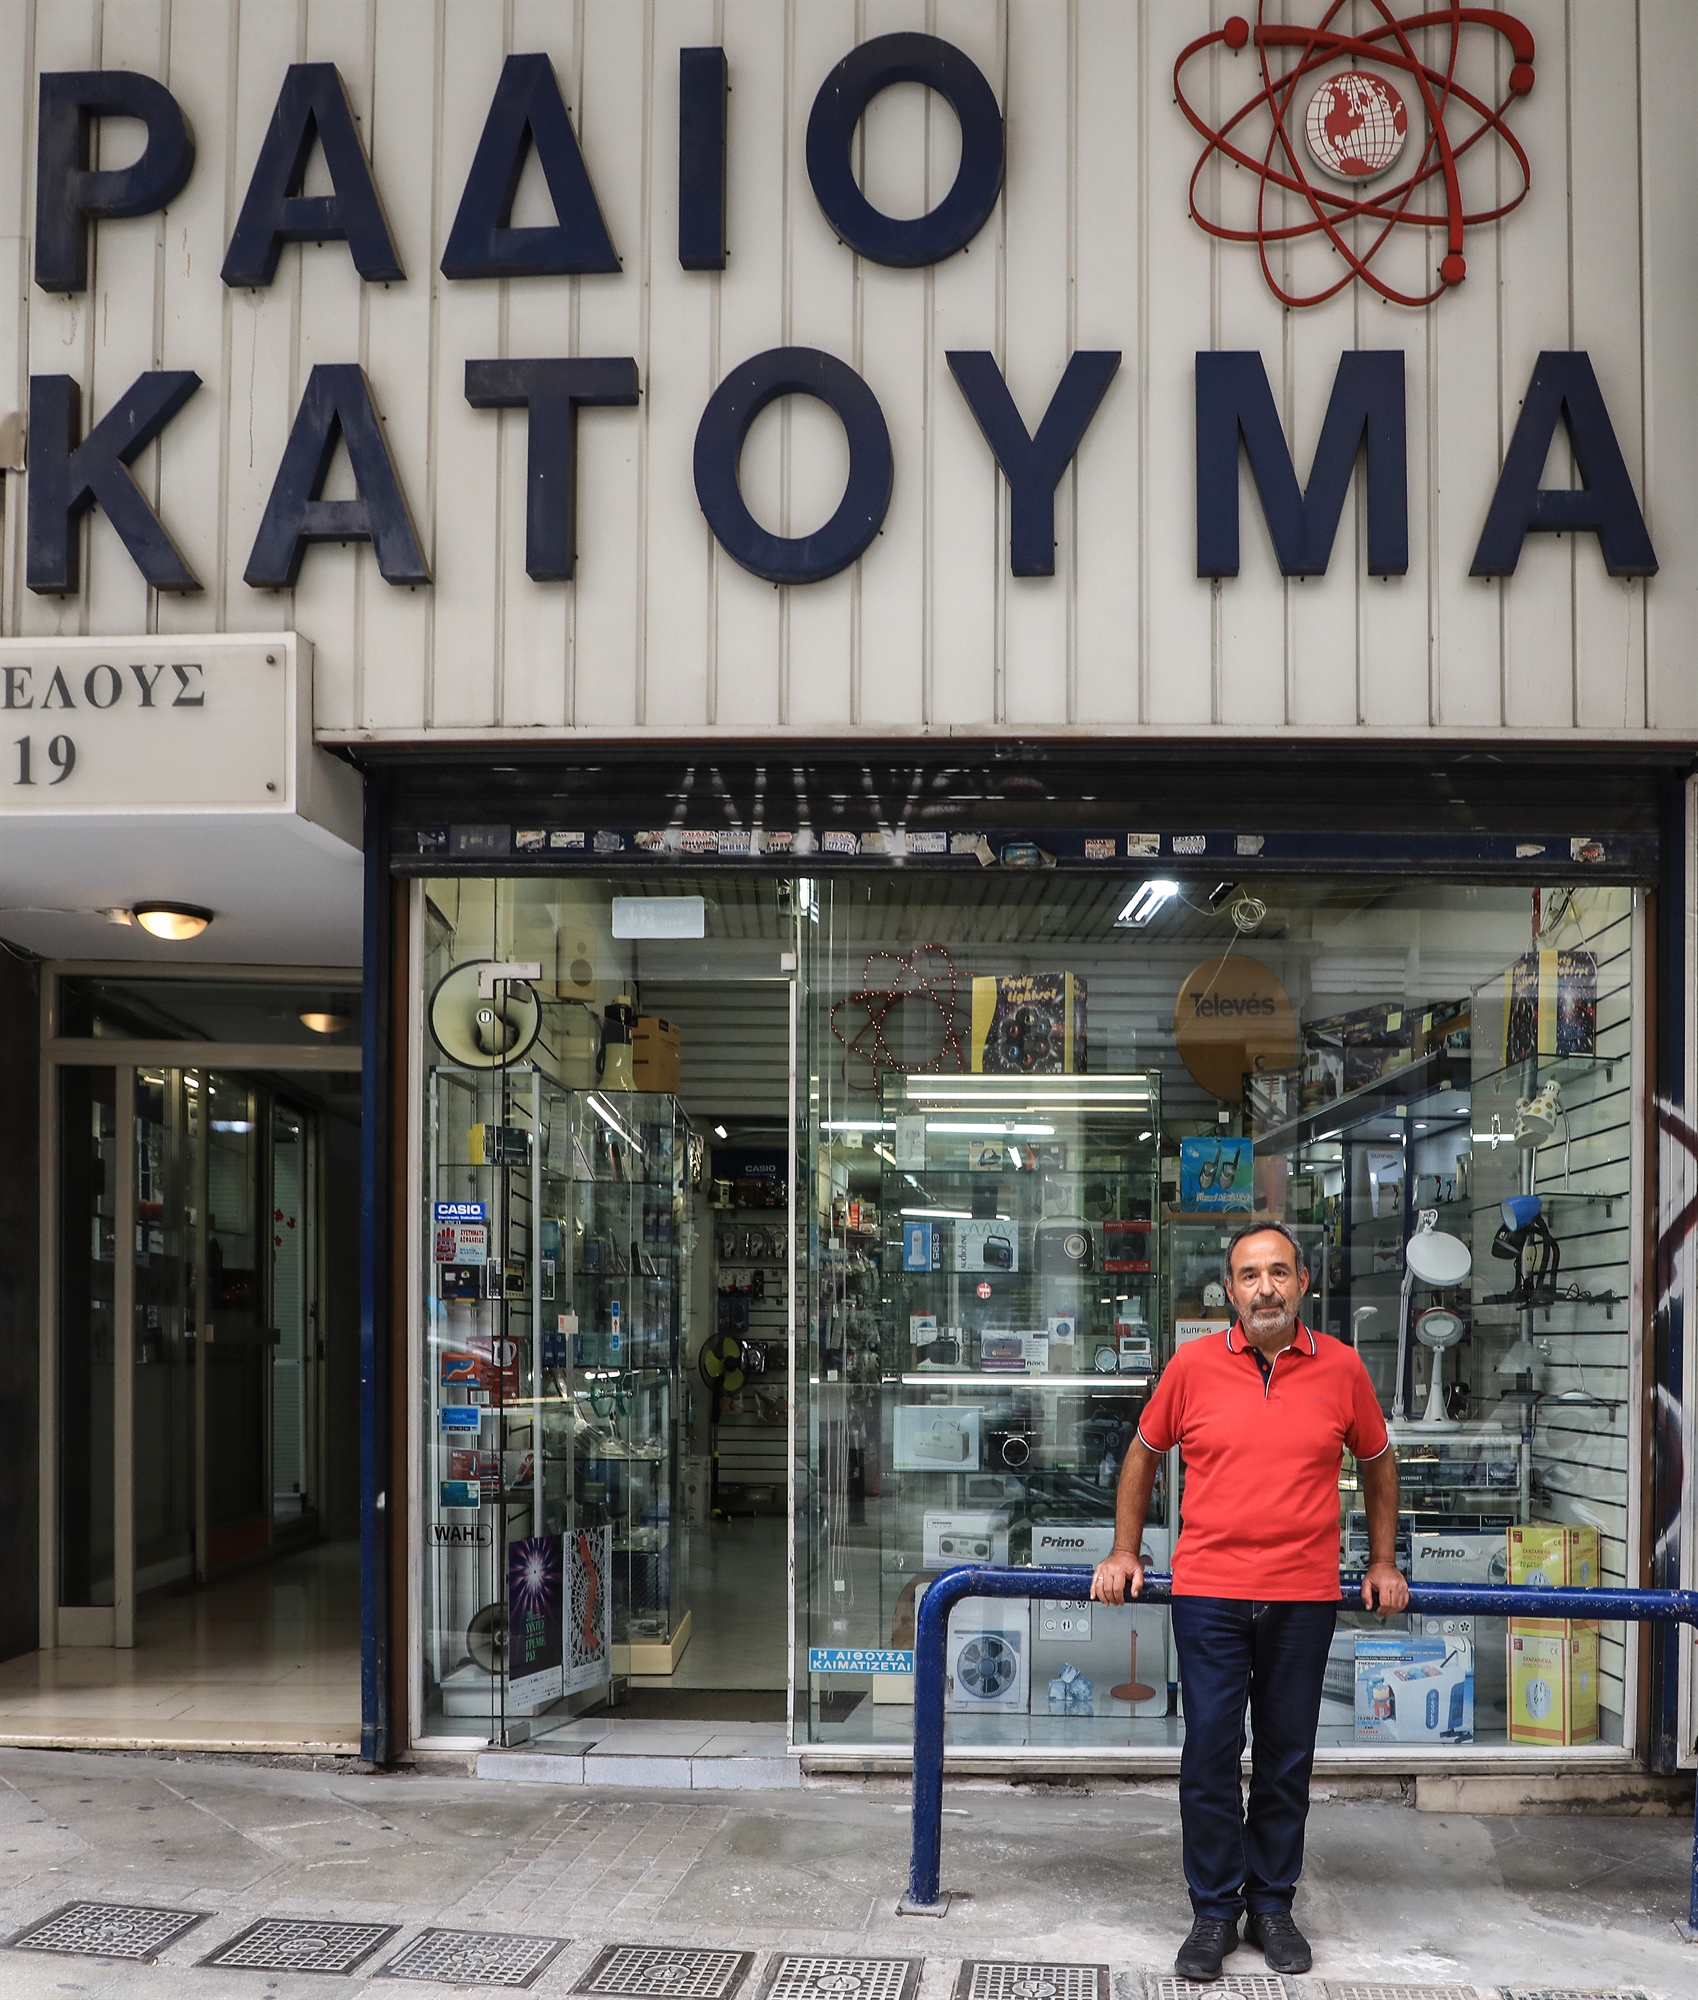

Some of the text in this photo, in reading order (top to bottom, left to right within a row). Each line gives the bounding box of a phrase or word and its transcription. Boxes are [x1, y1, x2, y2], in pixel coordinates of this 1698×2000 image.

[34, 32, 1005, 293] ΡΑΔΙΟ
[26, 346, 1660, 597] ΚΑΤΟΥΜΑ
[13, 735, 77, 785] 19
[1001, 976, 1034, 990] Party
[1190, 991, 1276, 1018] Televés
[745, 1164, 777, 1172] CASIO
[438, 1204, 481, 1215] CASIO
[434, 1526, 485, 1541] WAHL
[1041, 1536, 1085, 1548] Primo
[1421, 1547, 1465, 1559] Primo
[818, 1650, 905, 1661] Η ΑΙΘΟΥΣΑ
[1523, 1656, 1551, 1664] ZANZARIERA
[813, 1660, 911, 1671] ΚΛΙΜΑΤΙΖΕΤΑΙ
